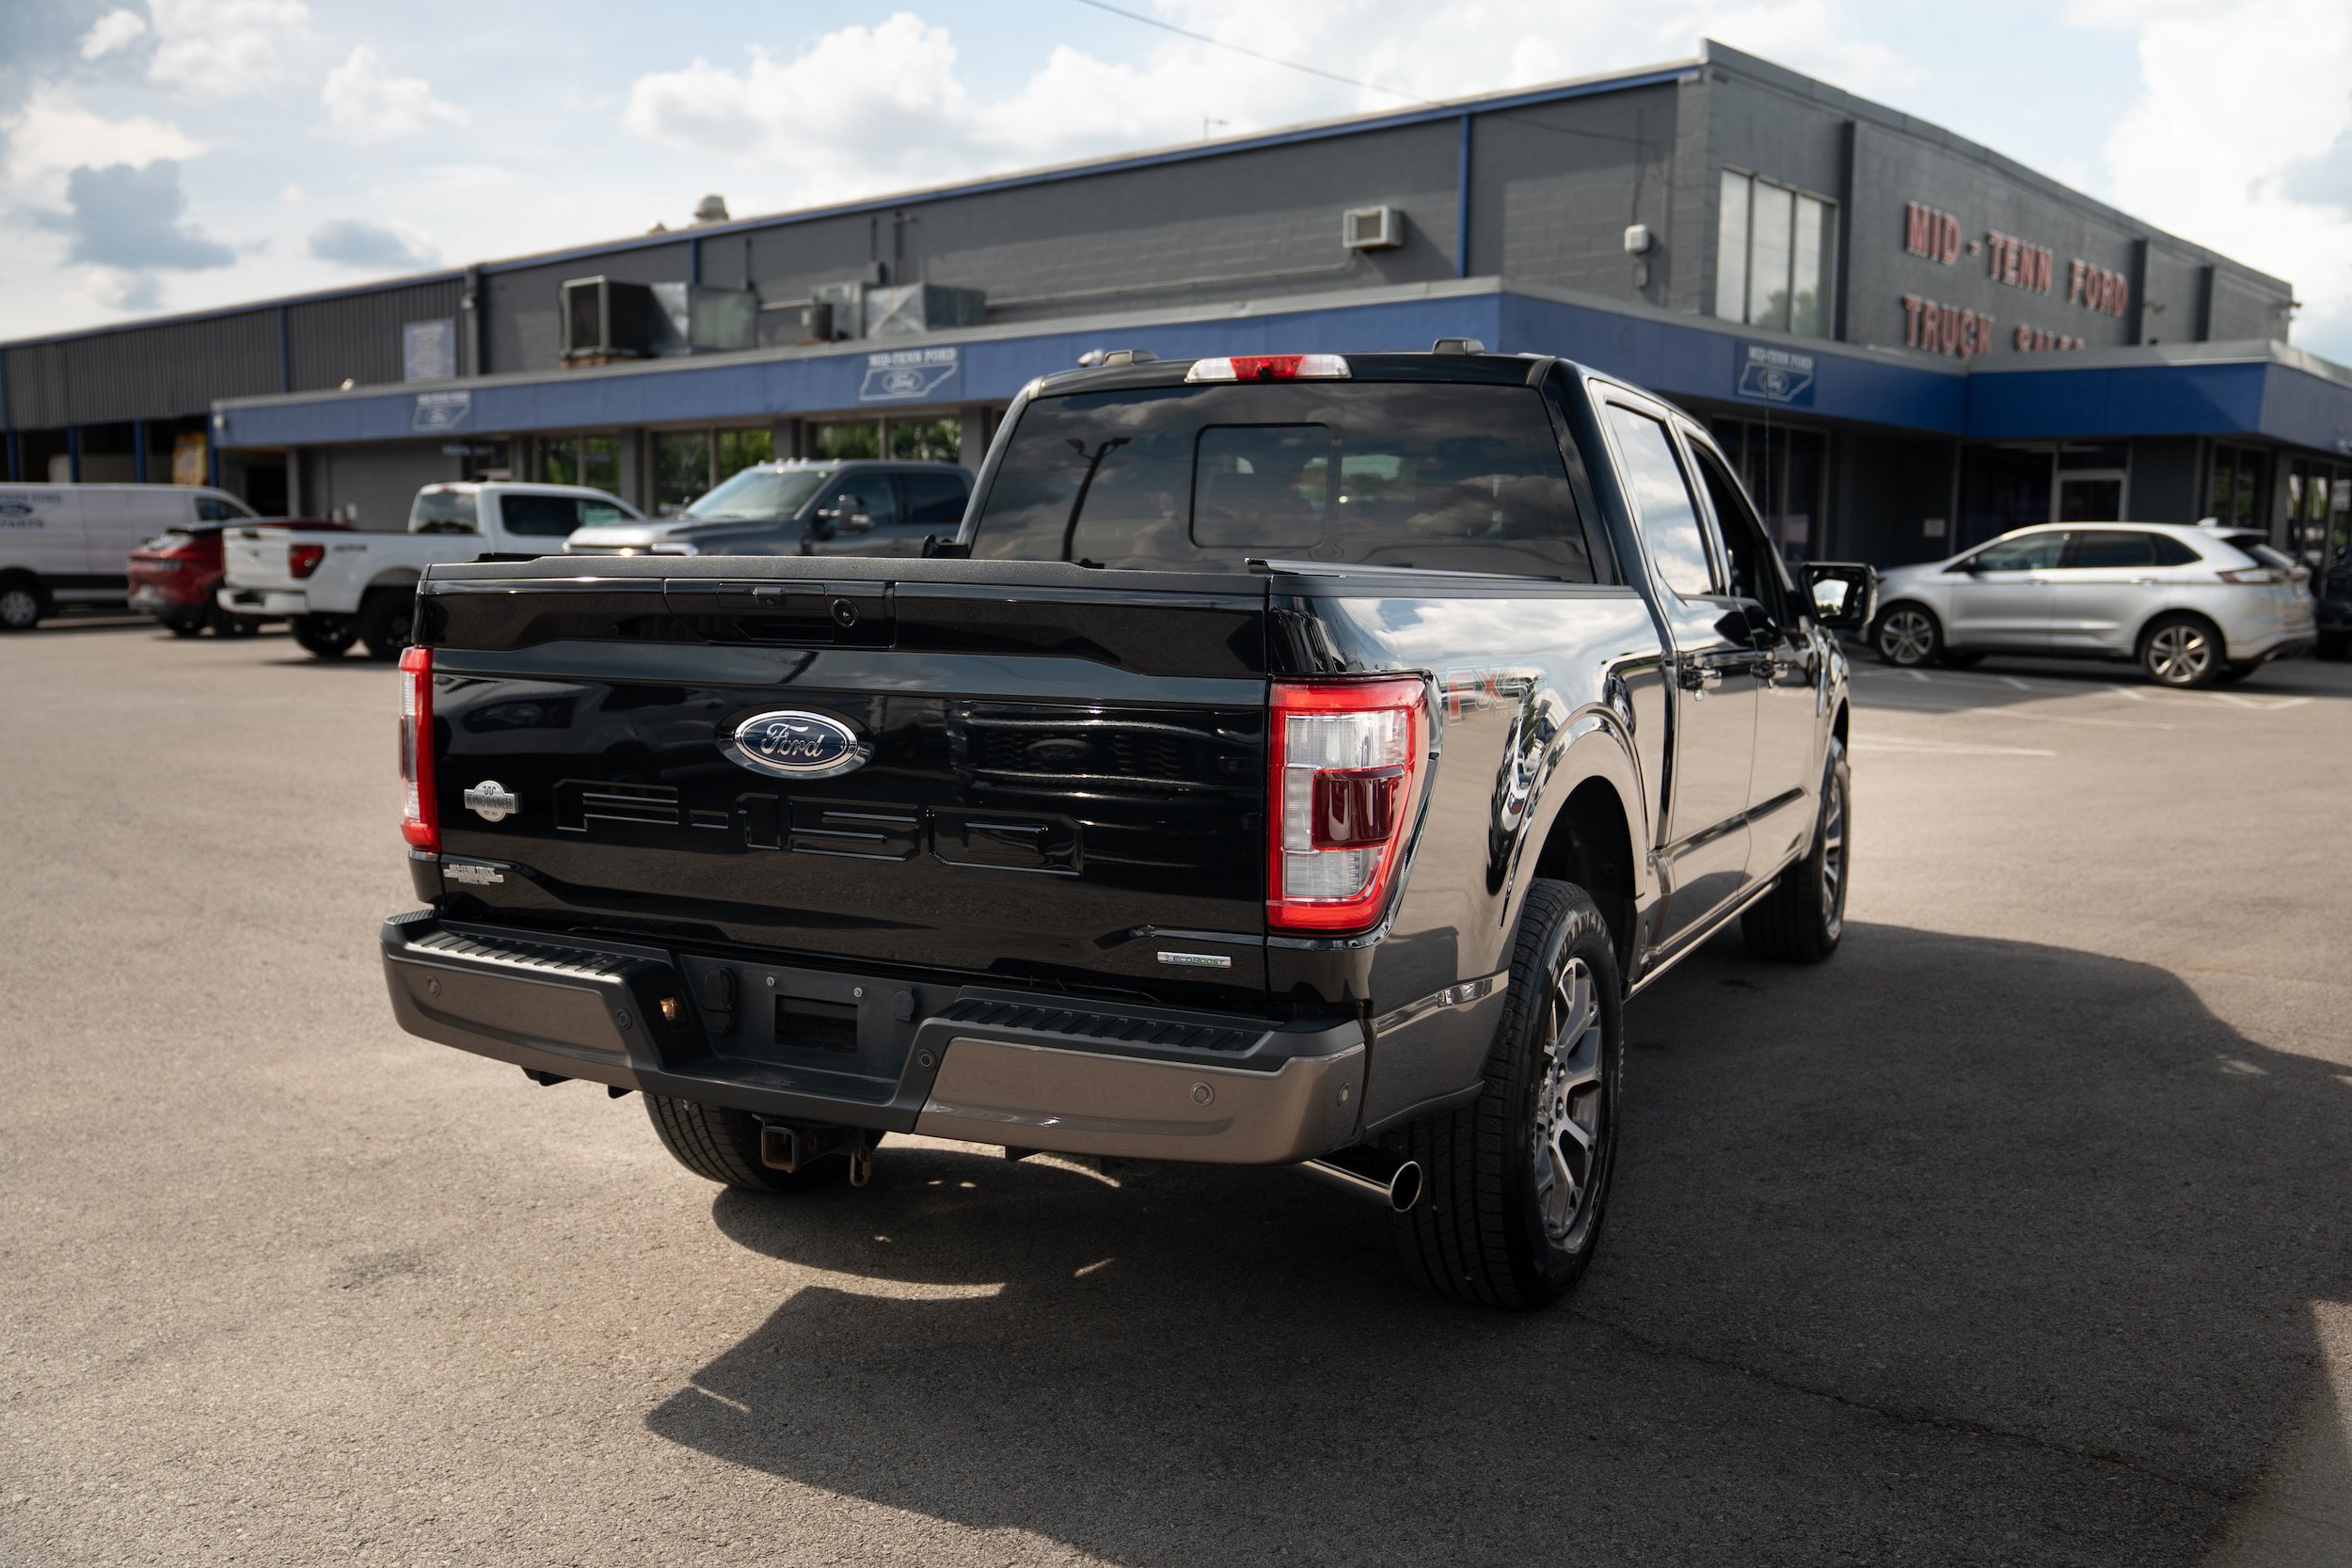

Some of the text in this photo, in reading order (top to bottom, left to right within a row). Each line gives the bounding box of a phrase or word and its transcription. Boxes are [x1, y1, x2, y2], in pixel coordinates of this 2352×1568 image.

[2069, 257, 2129, 317] FORD
[1902, 293, 1996, 359] TRUCK
[760, 722, 825, 757] Ford
[467, 793, 512, 810] KING RANCH
[551, 778, 1084, 877] F-150
[1173, 955, 1226, 966] ECOBOOST
